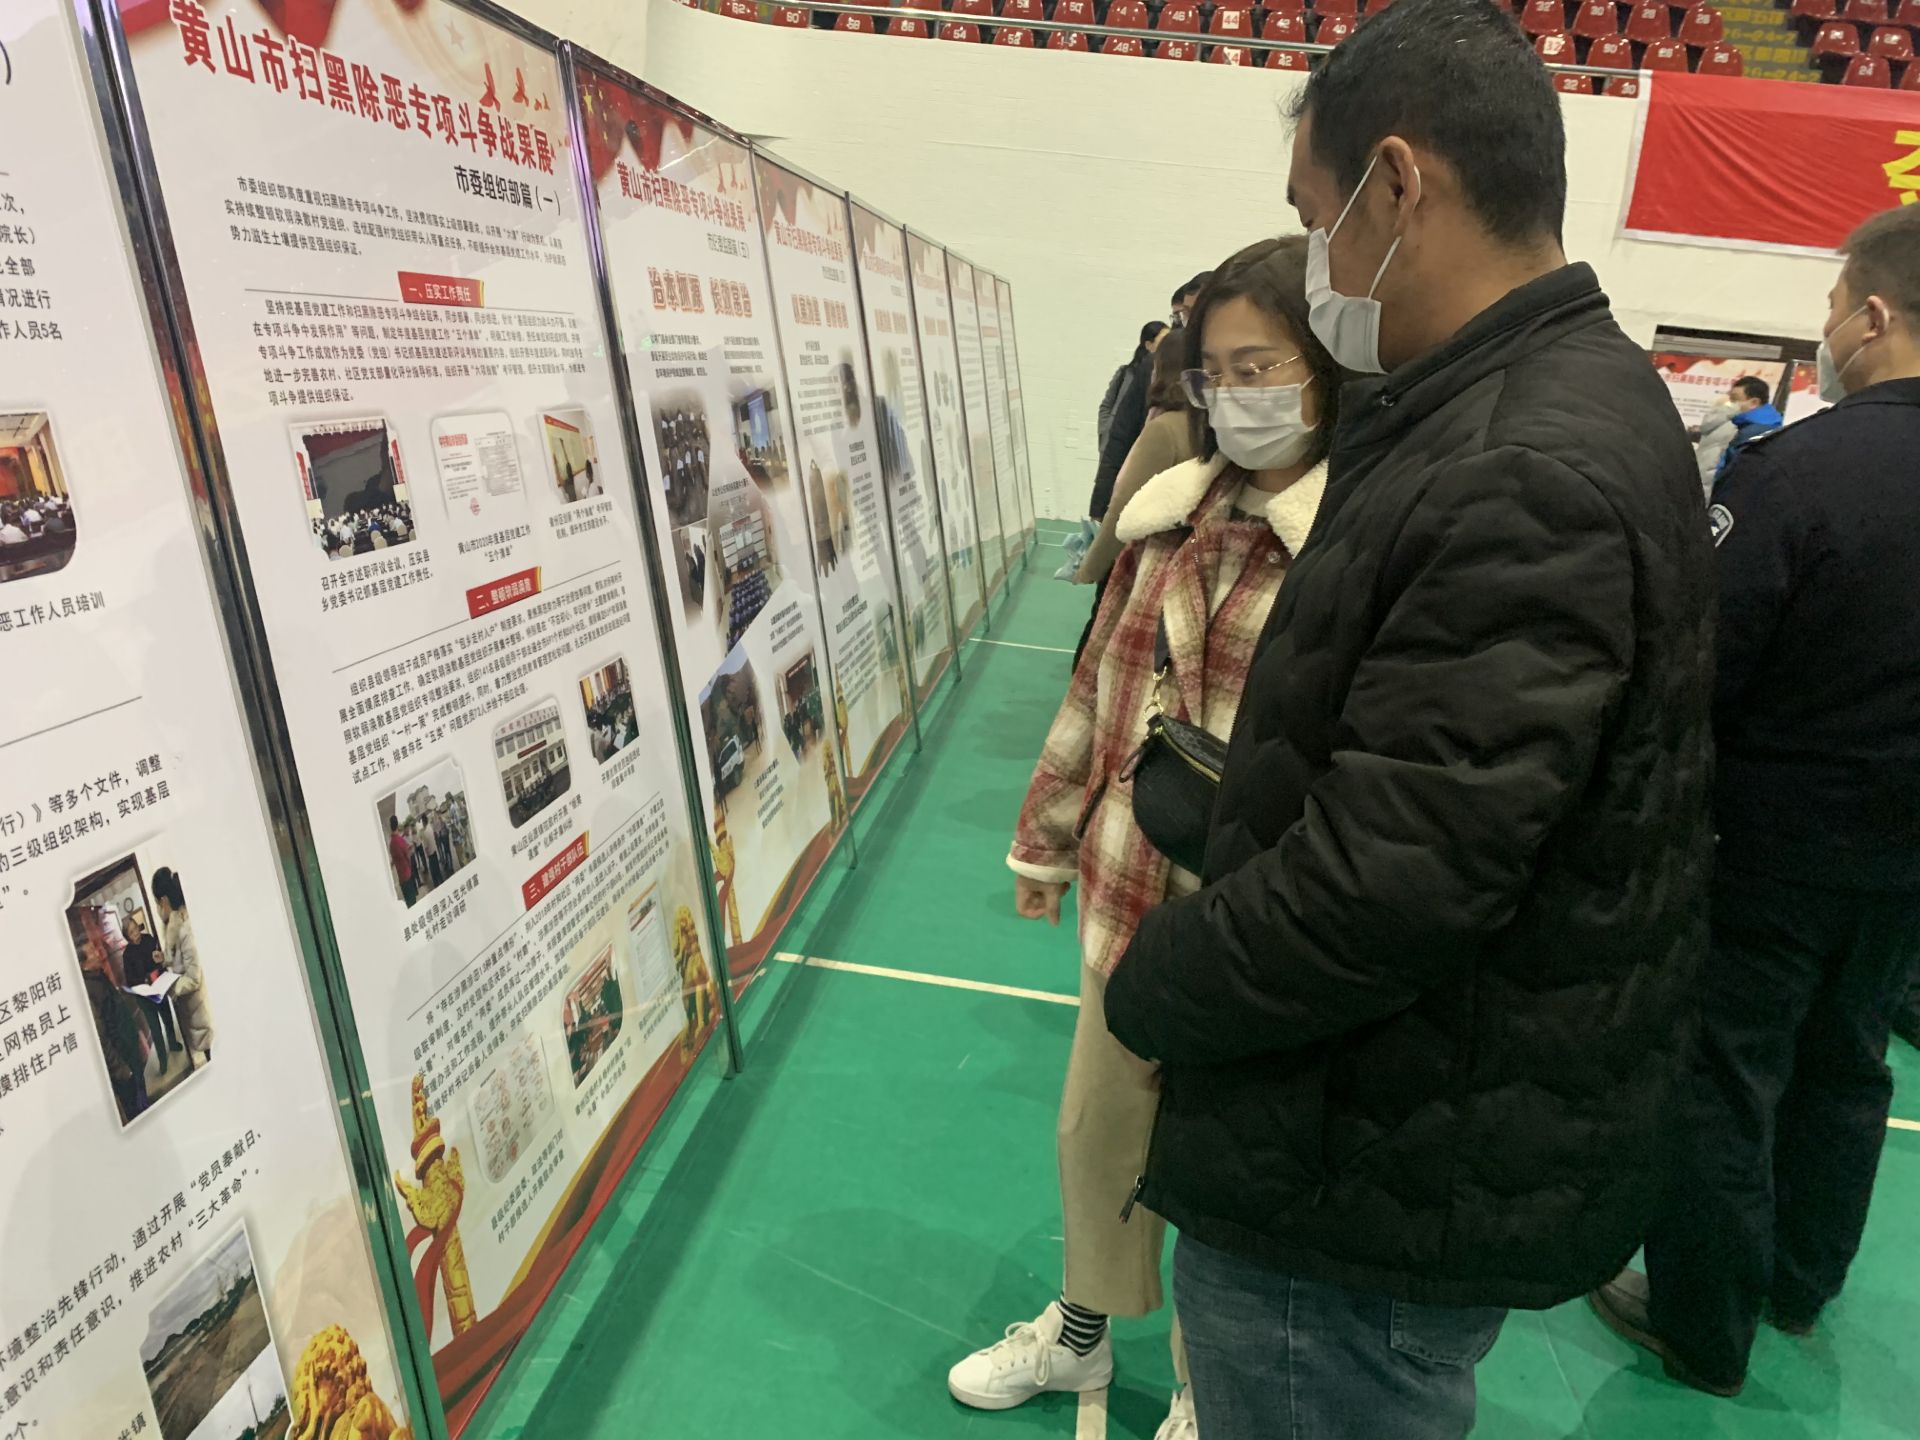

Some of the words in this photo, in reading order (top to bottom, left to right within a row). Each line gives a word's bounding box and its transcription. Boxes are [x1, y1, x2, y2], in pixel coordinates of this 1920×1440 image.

[953, 29, 967, 39] 54
[170, 0, 556, 176] 黄山市扫黑除恶专项斗争战果展
[453, 165, 561, 216] 市委组织部篇（一）
[0, 256, 35, 276] 全部
[406, 280, 473, 303] 一、压实工作责任
[0, 591, 106, 632] 恶工作人员培训
[0, 1004, 71, 1063] 网格员上
[0, 1167, 260, 1417] 意识和责任意识，推进农村“三大革命”。
